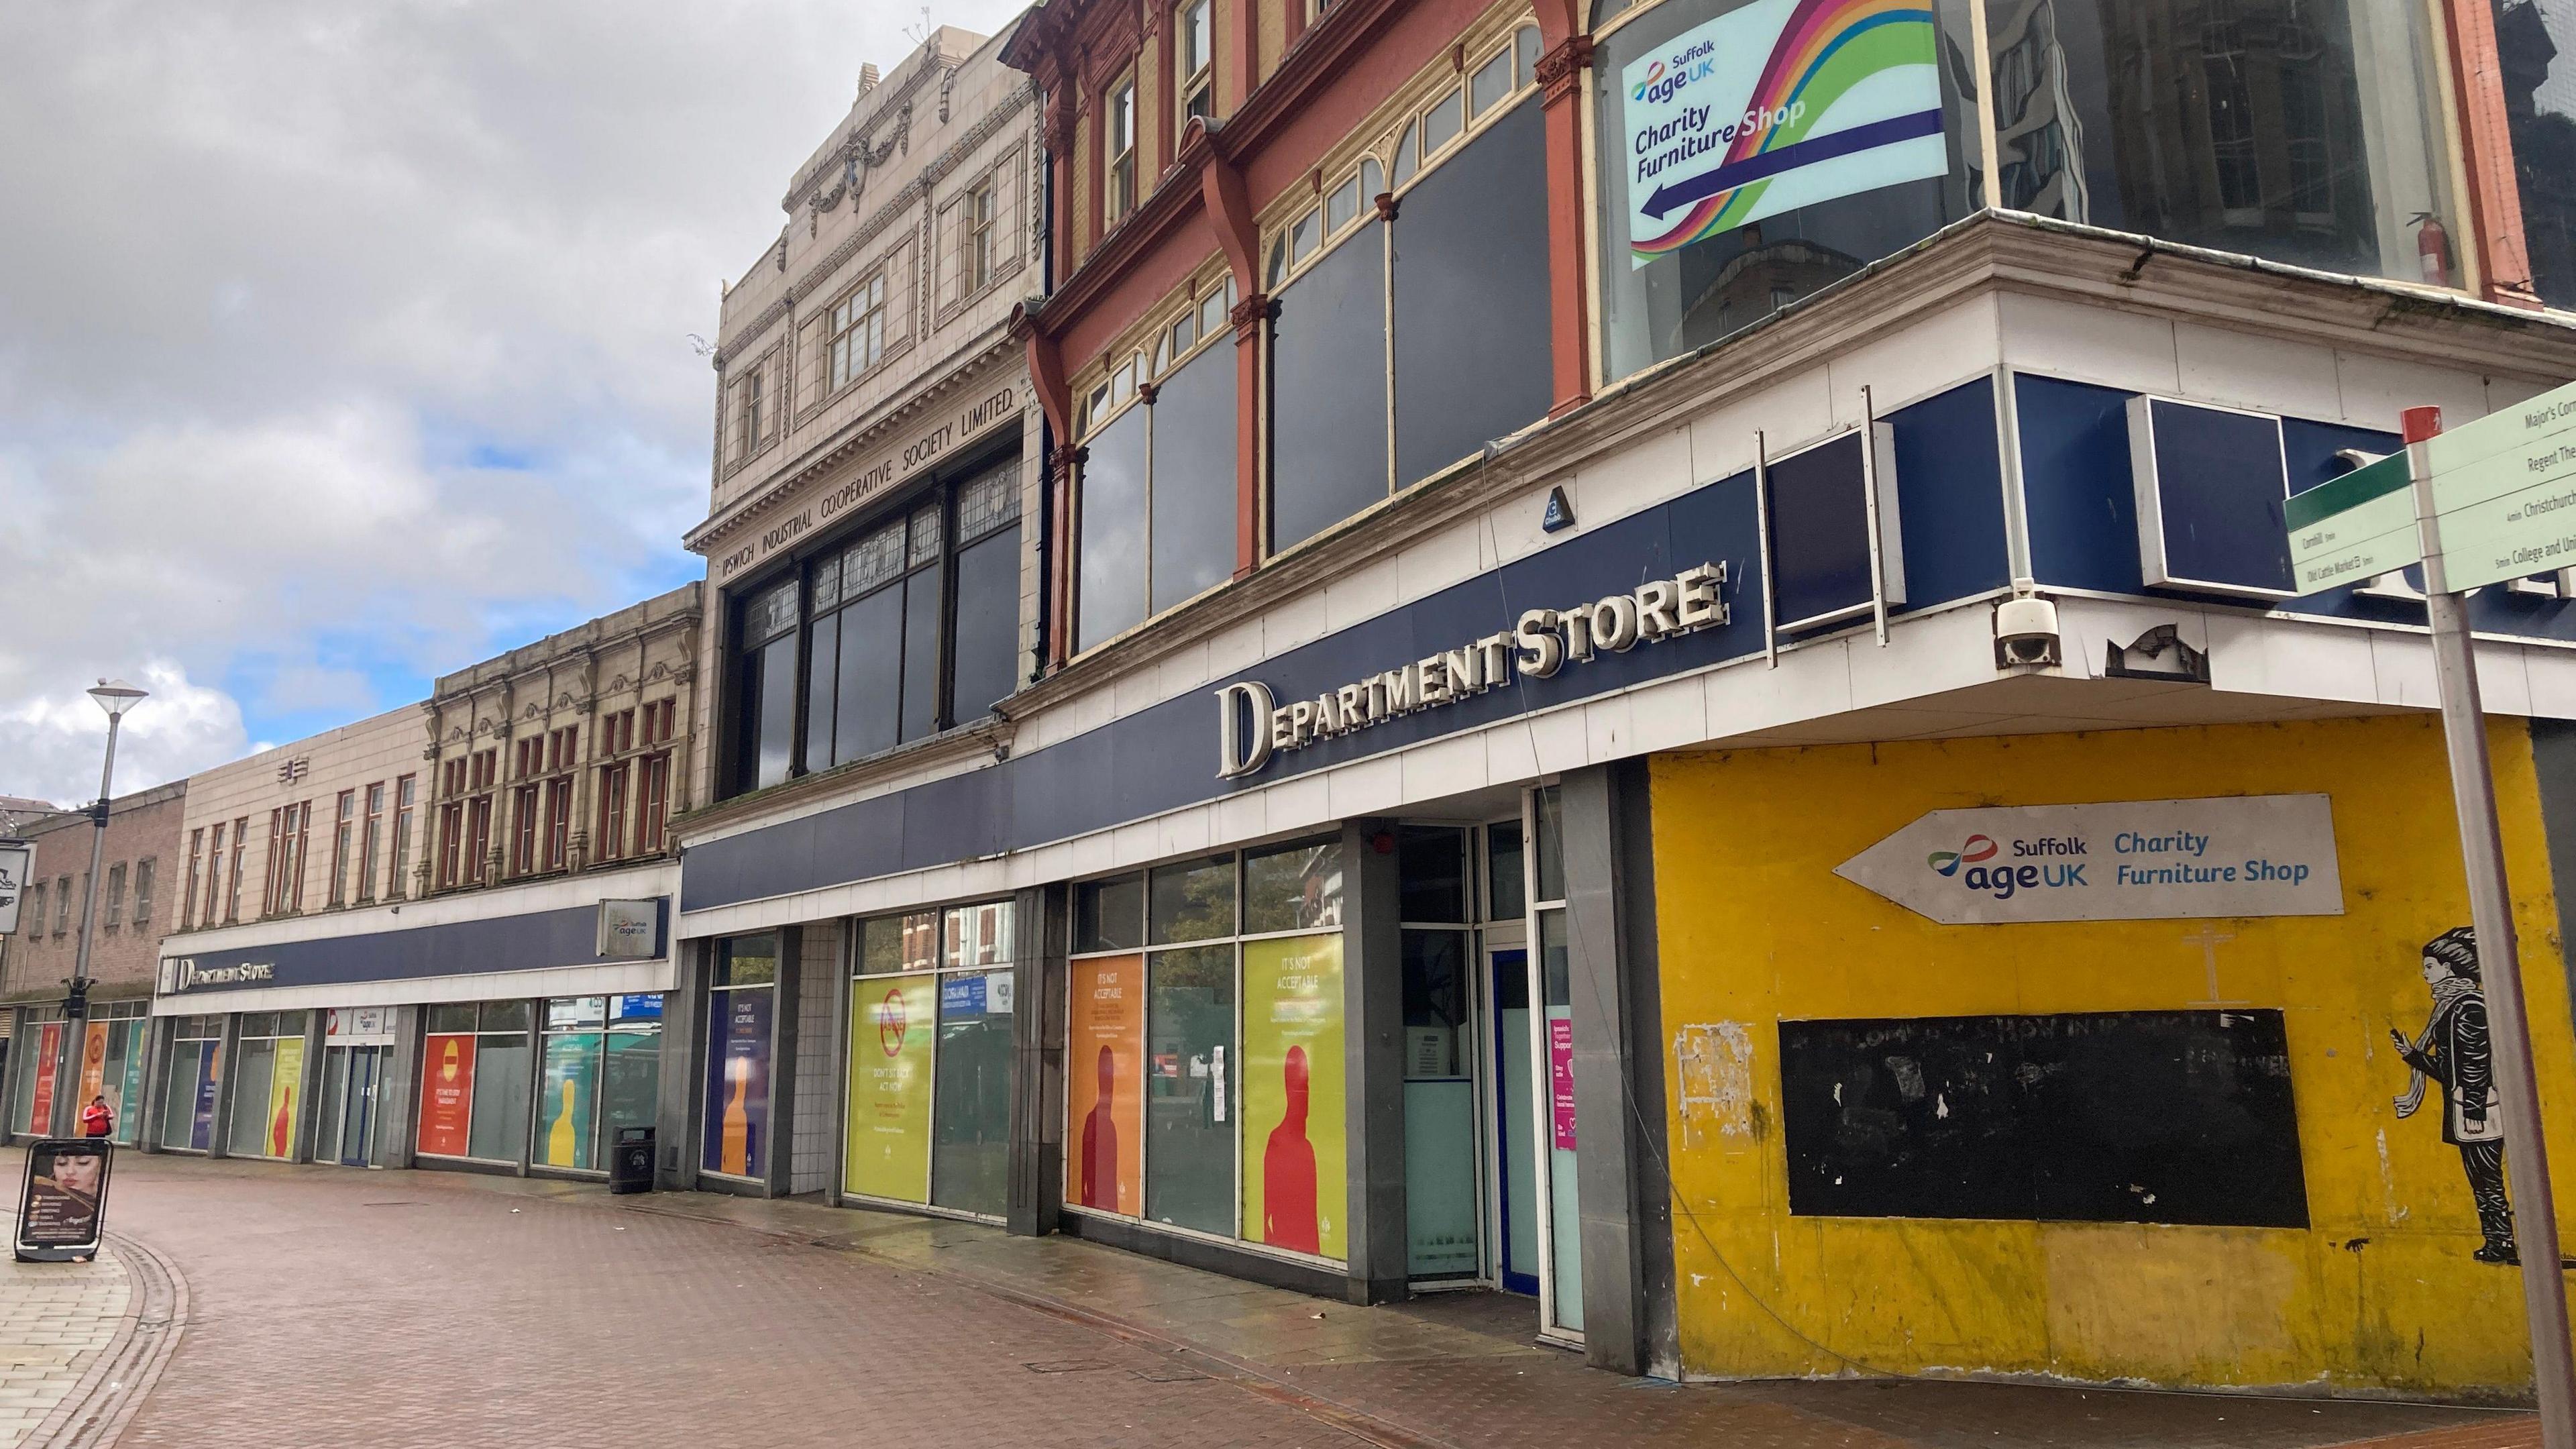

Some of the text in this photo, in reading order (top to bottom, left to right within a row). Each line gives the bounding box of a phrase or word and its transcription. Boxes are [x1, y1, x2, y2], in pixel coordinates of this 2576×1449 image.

[1672, 40, 1715, 69] Suffolk
[1635, 105, 1711, 155] Charity
[1638, 100, 1806, 184] Furniture Shop
[2524, 407, 2557, 429] Major's
[2527, 450, 2559, 472] Regent
[722, 543, 755, 578] IPSWICH
[762, 508, 813, 555] INDUSTRIAL
[903, 421, 953, 471] SOCIETY
[2512, 547, 2543, 564] College
[2545, 538, 2561, 557] and
[2334, 559, 2355, 575] Market
[1214, 560, 1730, 781] DEPARTMENT STORE
[2012, 837, 2088, 857] Suffolk
[2114, 830, 2209, 857] Charity
[2117, 859, 2310, 886] Furniture Shop
[1295, 956, 1311, 970] NOT
[1106, 973, 1117, 984] NOT
[1277, 975, 1318, 989] ACCEPTABLE
[1093, 987, 1122, 999] ACCEPTABLE
